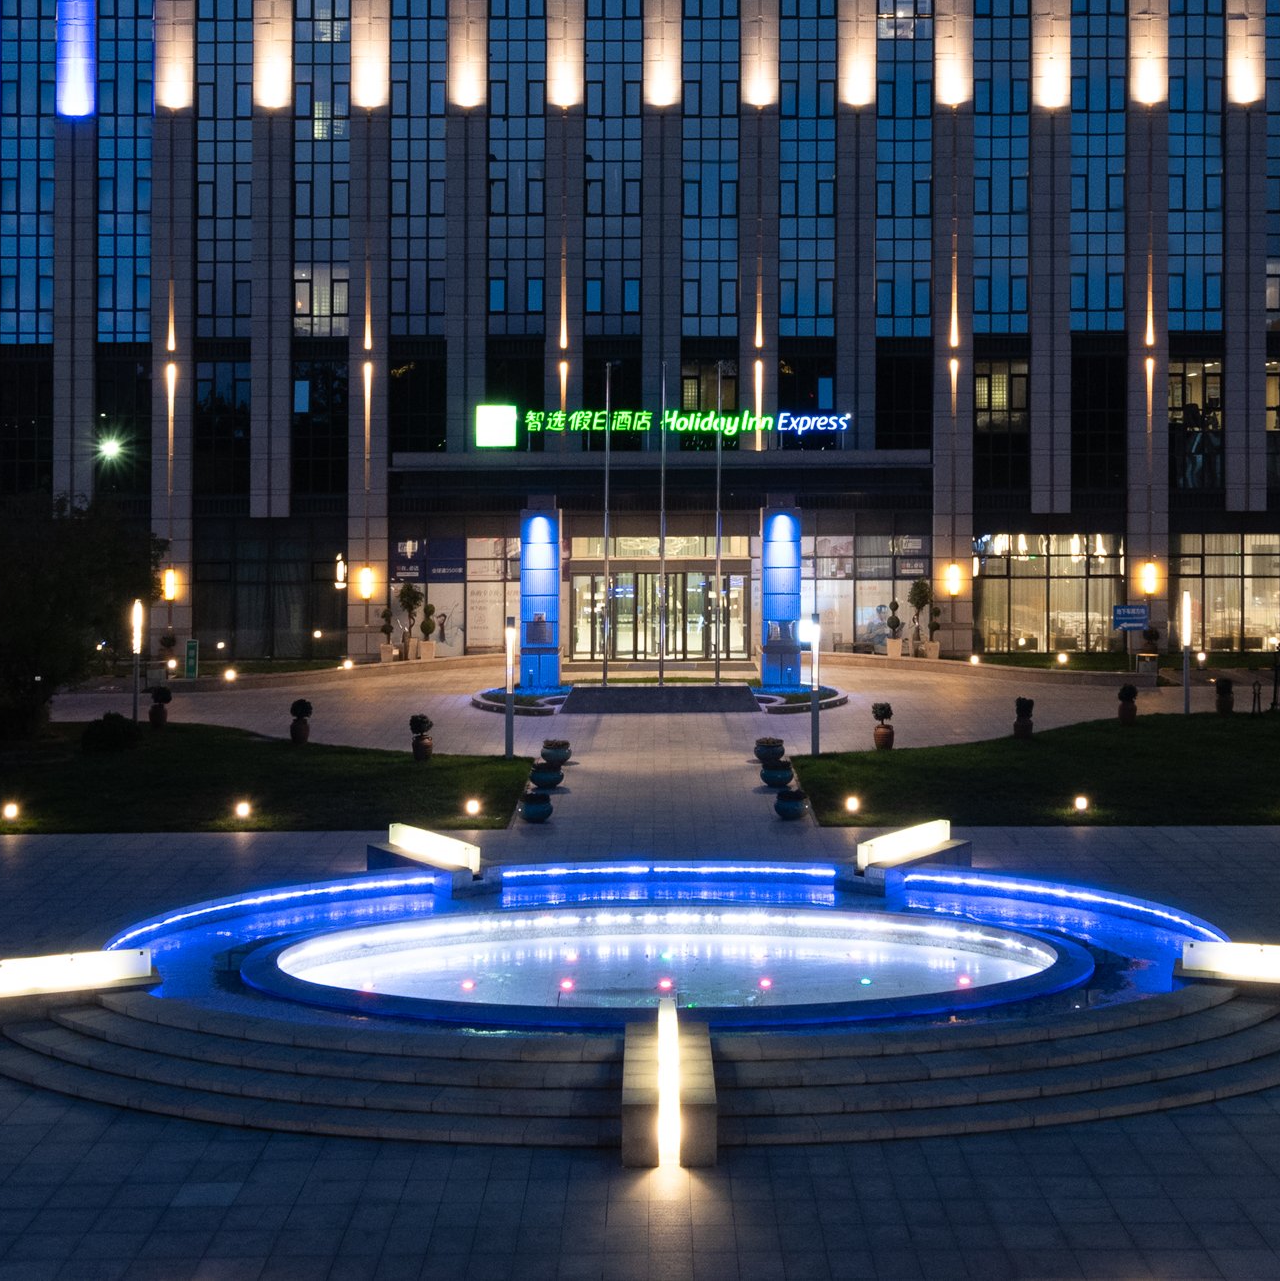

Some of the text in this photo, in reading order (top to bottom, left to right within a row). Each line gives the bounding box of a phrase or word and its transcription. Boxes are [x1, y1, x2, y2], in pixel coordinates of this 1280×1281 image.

[524, 409, 653, 432] 智选假日酒店
[660, 409, 848, 436] Holiday Inn Express
